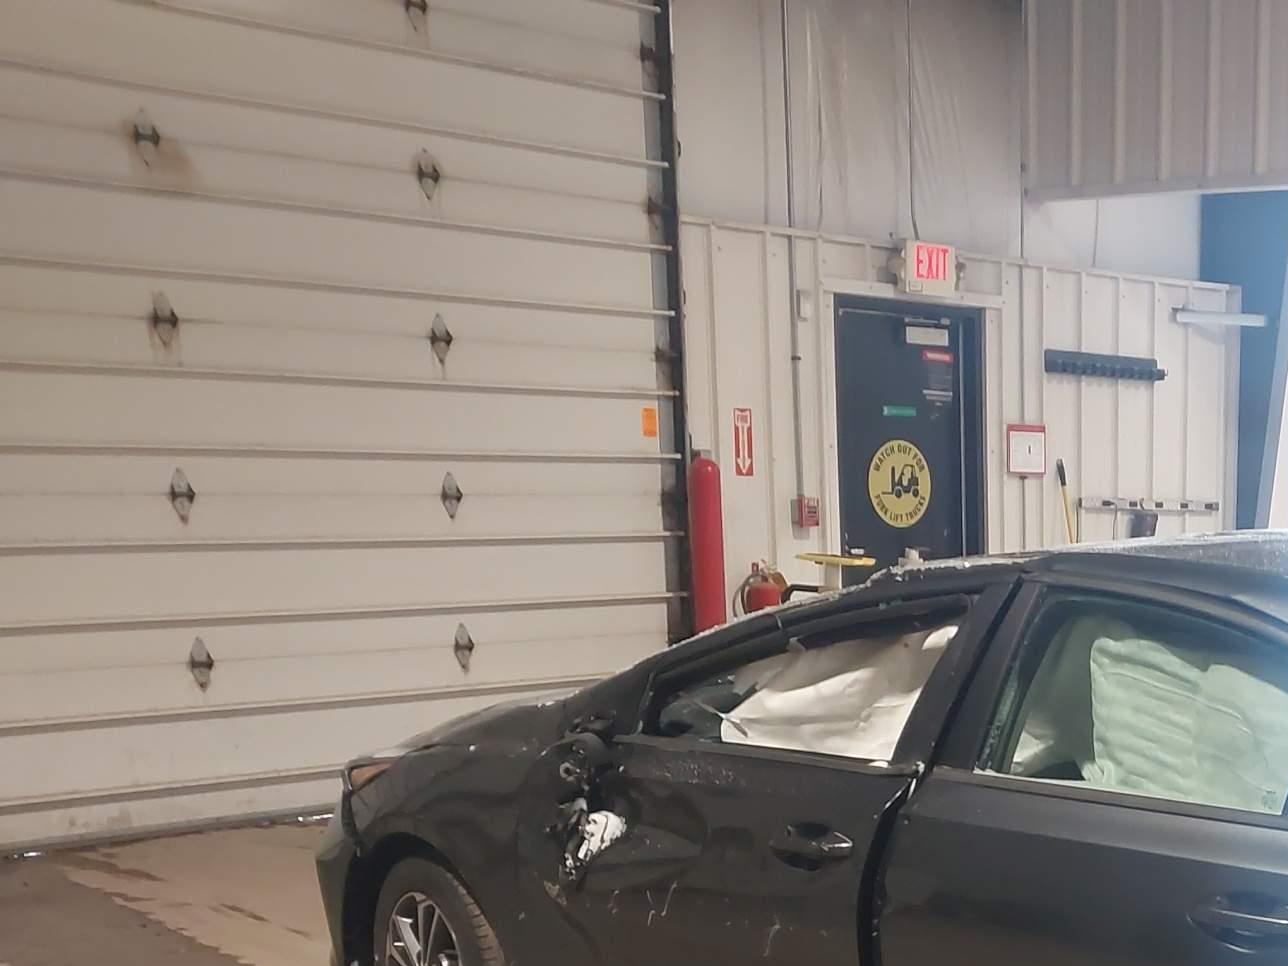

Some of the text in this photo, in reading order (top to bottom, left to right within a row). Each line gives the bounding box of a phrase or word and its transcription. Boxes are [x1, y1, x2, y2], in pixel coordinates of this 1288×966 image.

[916, 245, 950, 281] EXIT
[873, 443, 926, 473] WATCH OUT FOR
[889, 511, 904, 523] LIFT
[904, 495, 926, 521] TRUCKS
